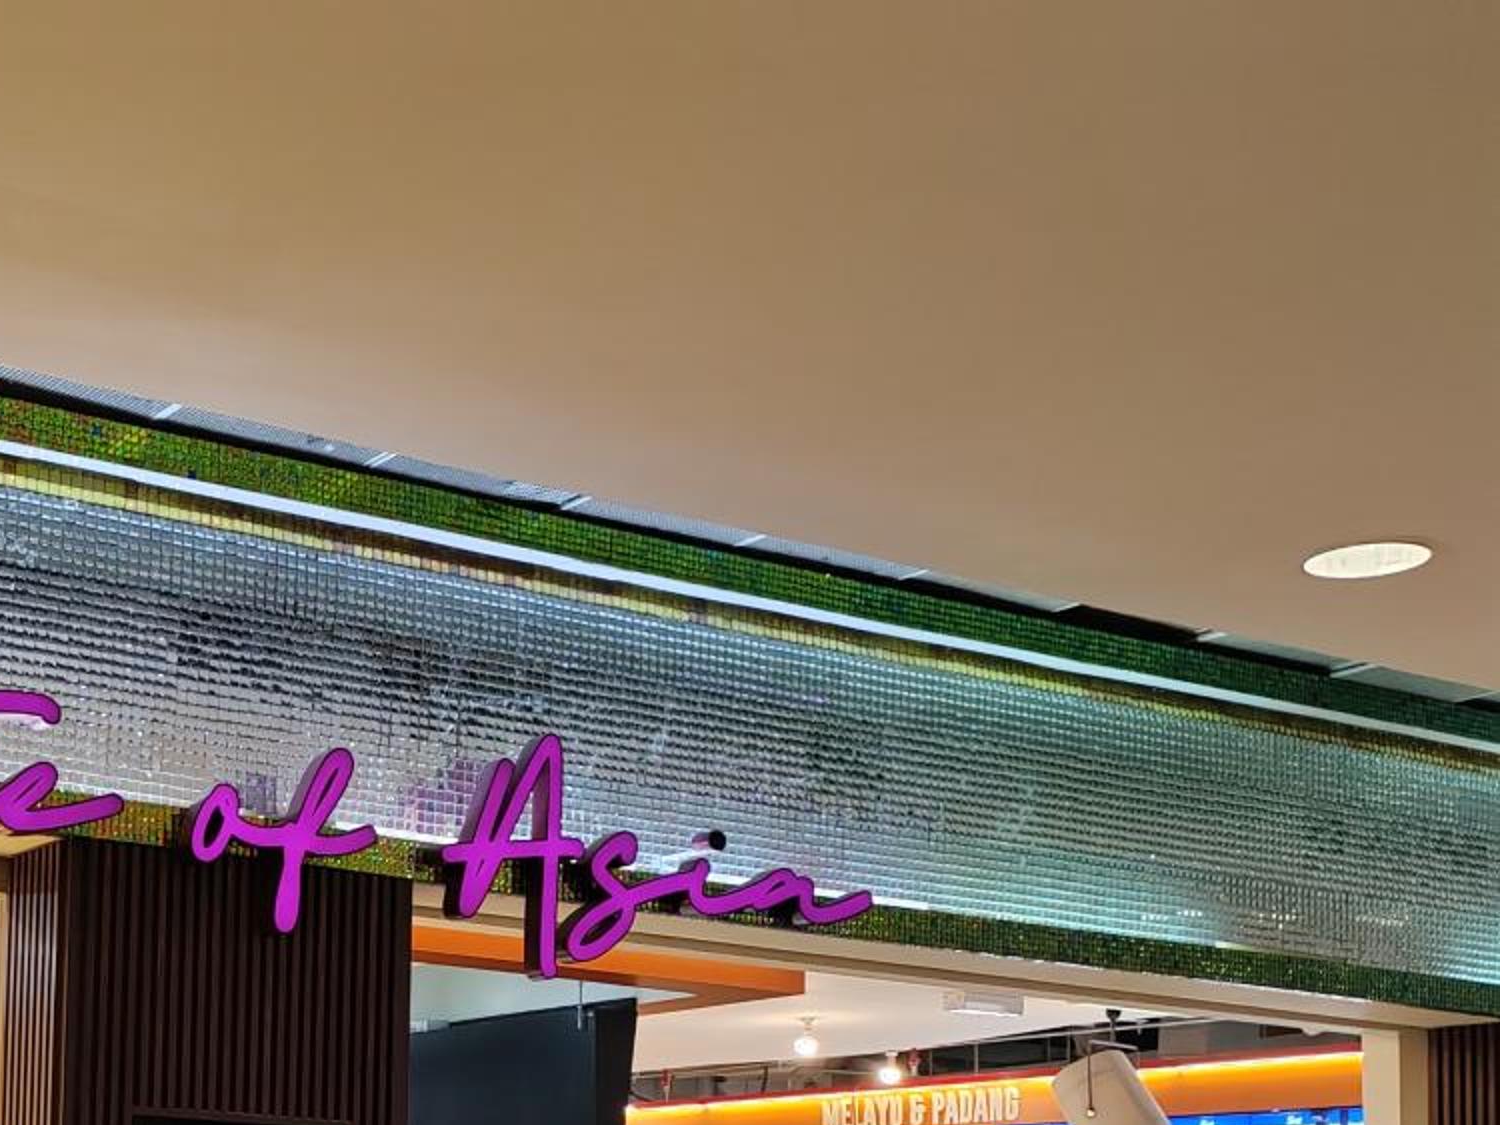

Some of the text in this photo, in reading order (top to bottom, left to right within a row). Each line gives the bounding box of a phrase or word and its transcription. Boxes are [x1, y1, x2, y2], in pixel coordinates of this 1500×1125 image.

[190, 746, 377, 934] of
[443, 733, 874, 980] Asia
[931, 1086, 1021, 1125] PADANG
